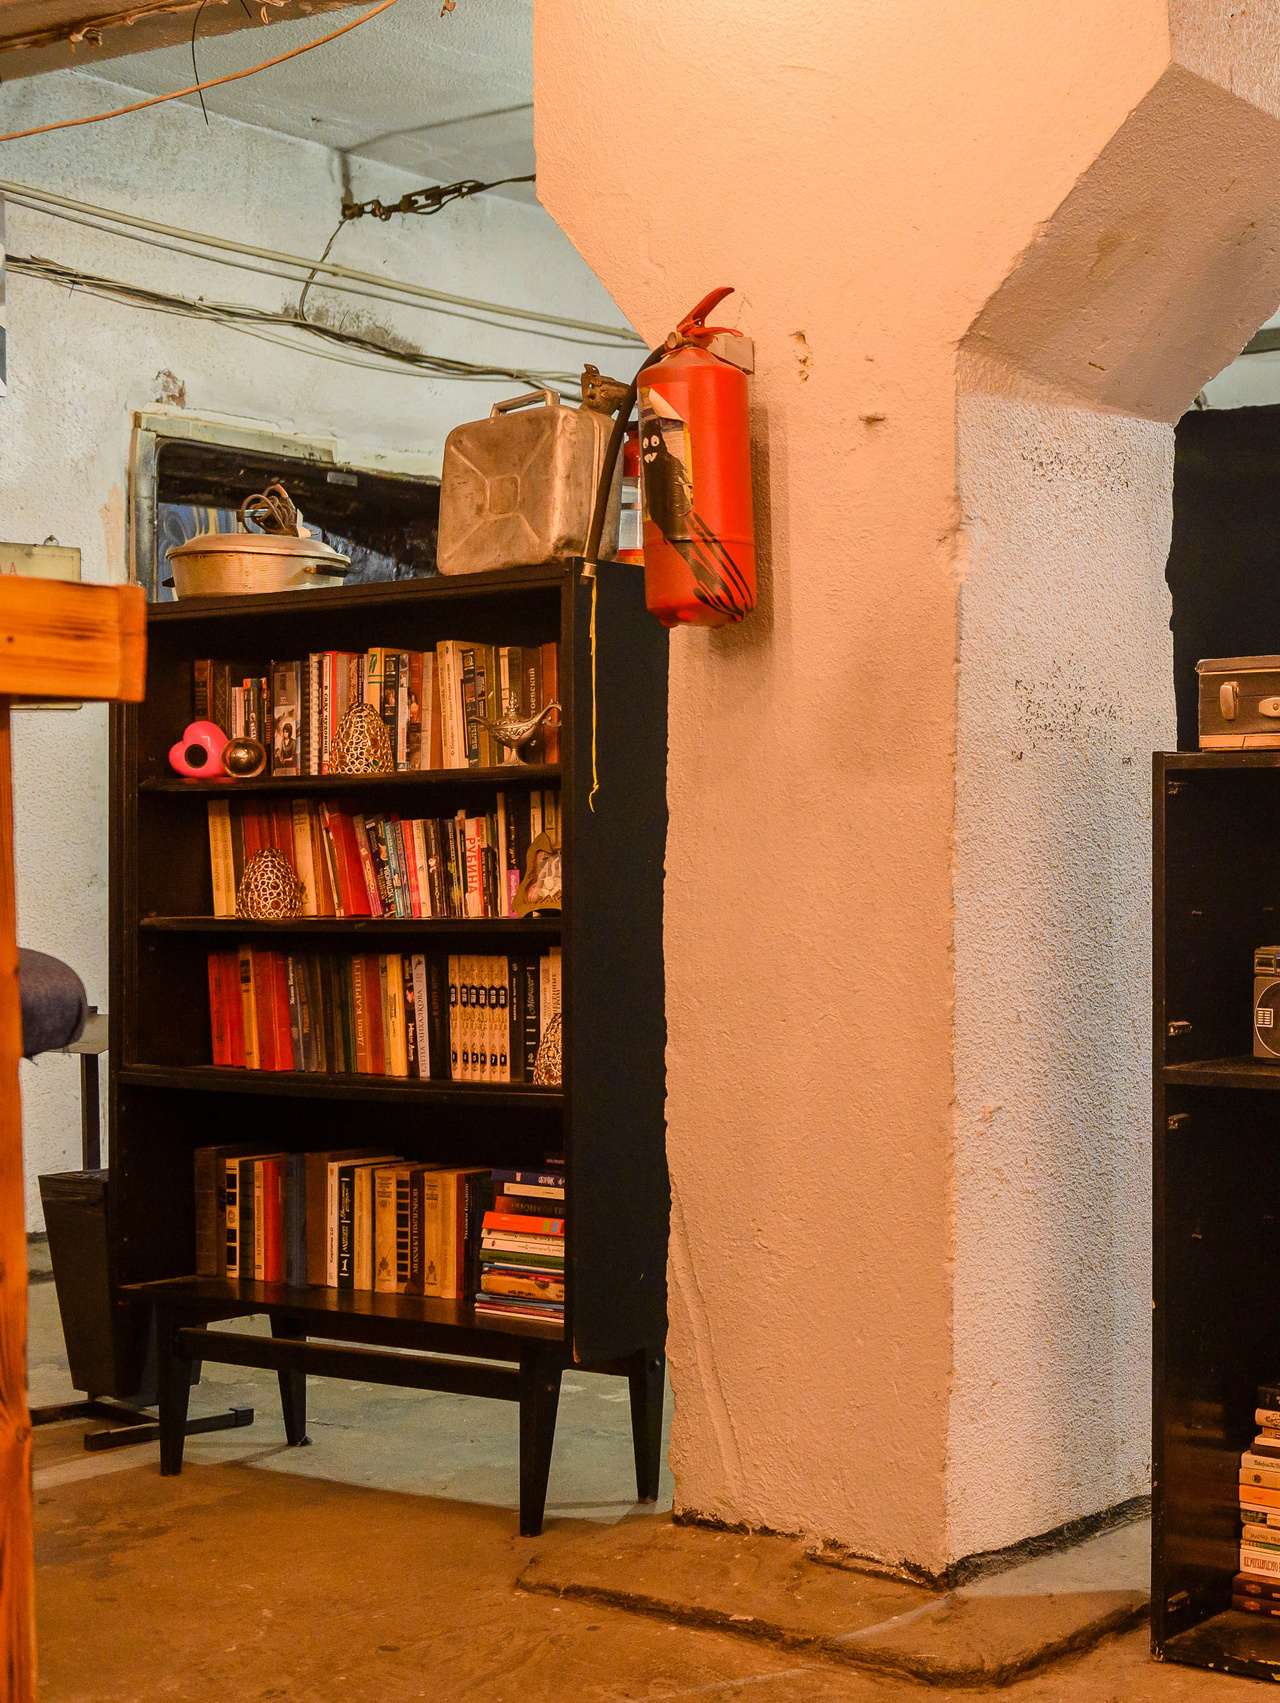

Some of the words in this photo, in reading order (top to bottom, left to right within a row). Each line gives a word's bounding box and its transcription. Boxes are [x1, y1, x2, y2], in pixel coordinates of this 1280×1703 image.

[465, 836, 478, 894] РУБИНА
[354, 960, 363, 1015] КАРНЕГИ
[357, 1019, 365, 1046] Дейл
[416, 989, 425, 1043] МИХАЛКОВА
[419, 1045, 427, 1073] ЕЛЕНА
